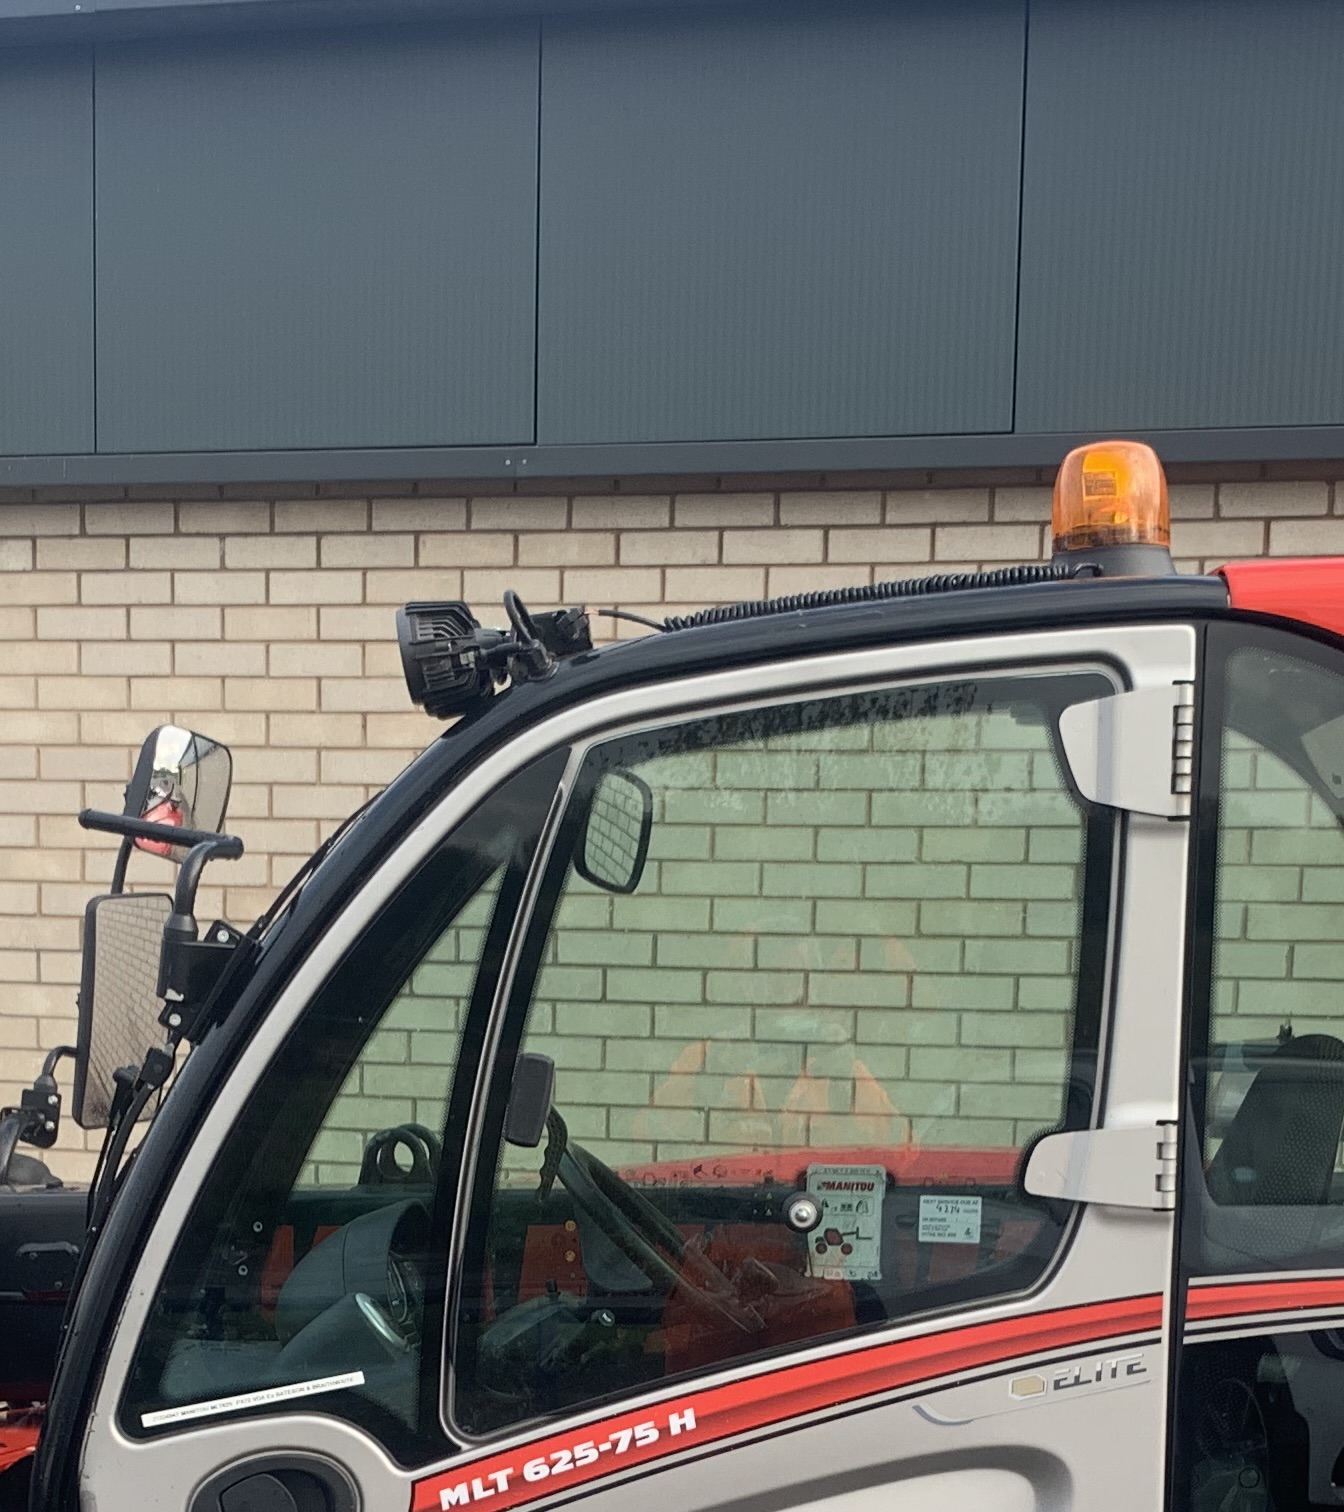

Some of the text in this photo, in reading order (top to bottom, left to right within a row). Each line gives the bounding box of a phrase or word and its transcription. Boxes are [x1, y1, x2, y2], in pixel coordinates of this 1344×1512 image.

[822, 1181, 875, 1192] MANITOU
[1053, 1353, 1148, 1391] ELITE
[439, 1407, 697, 1512] MLT 625-75 H
